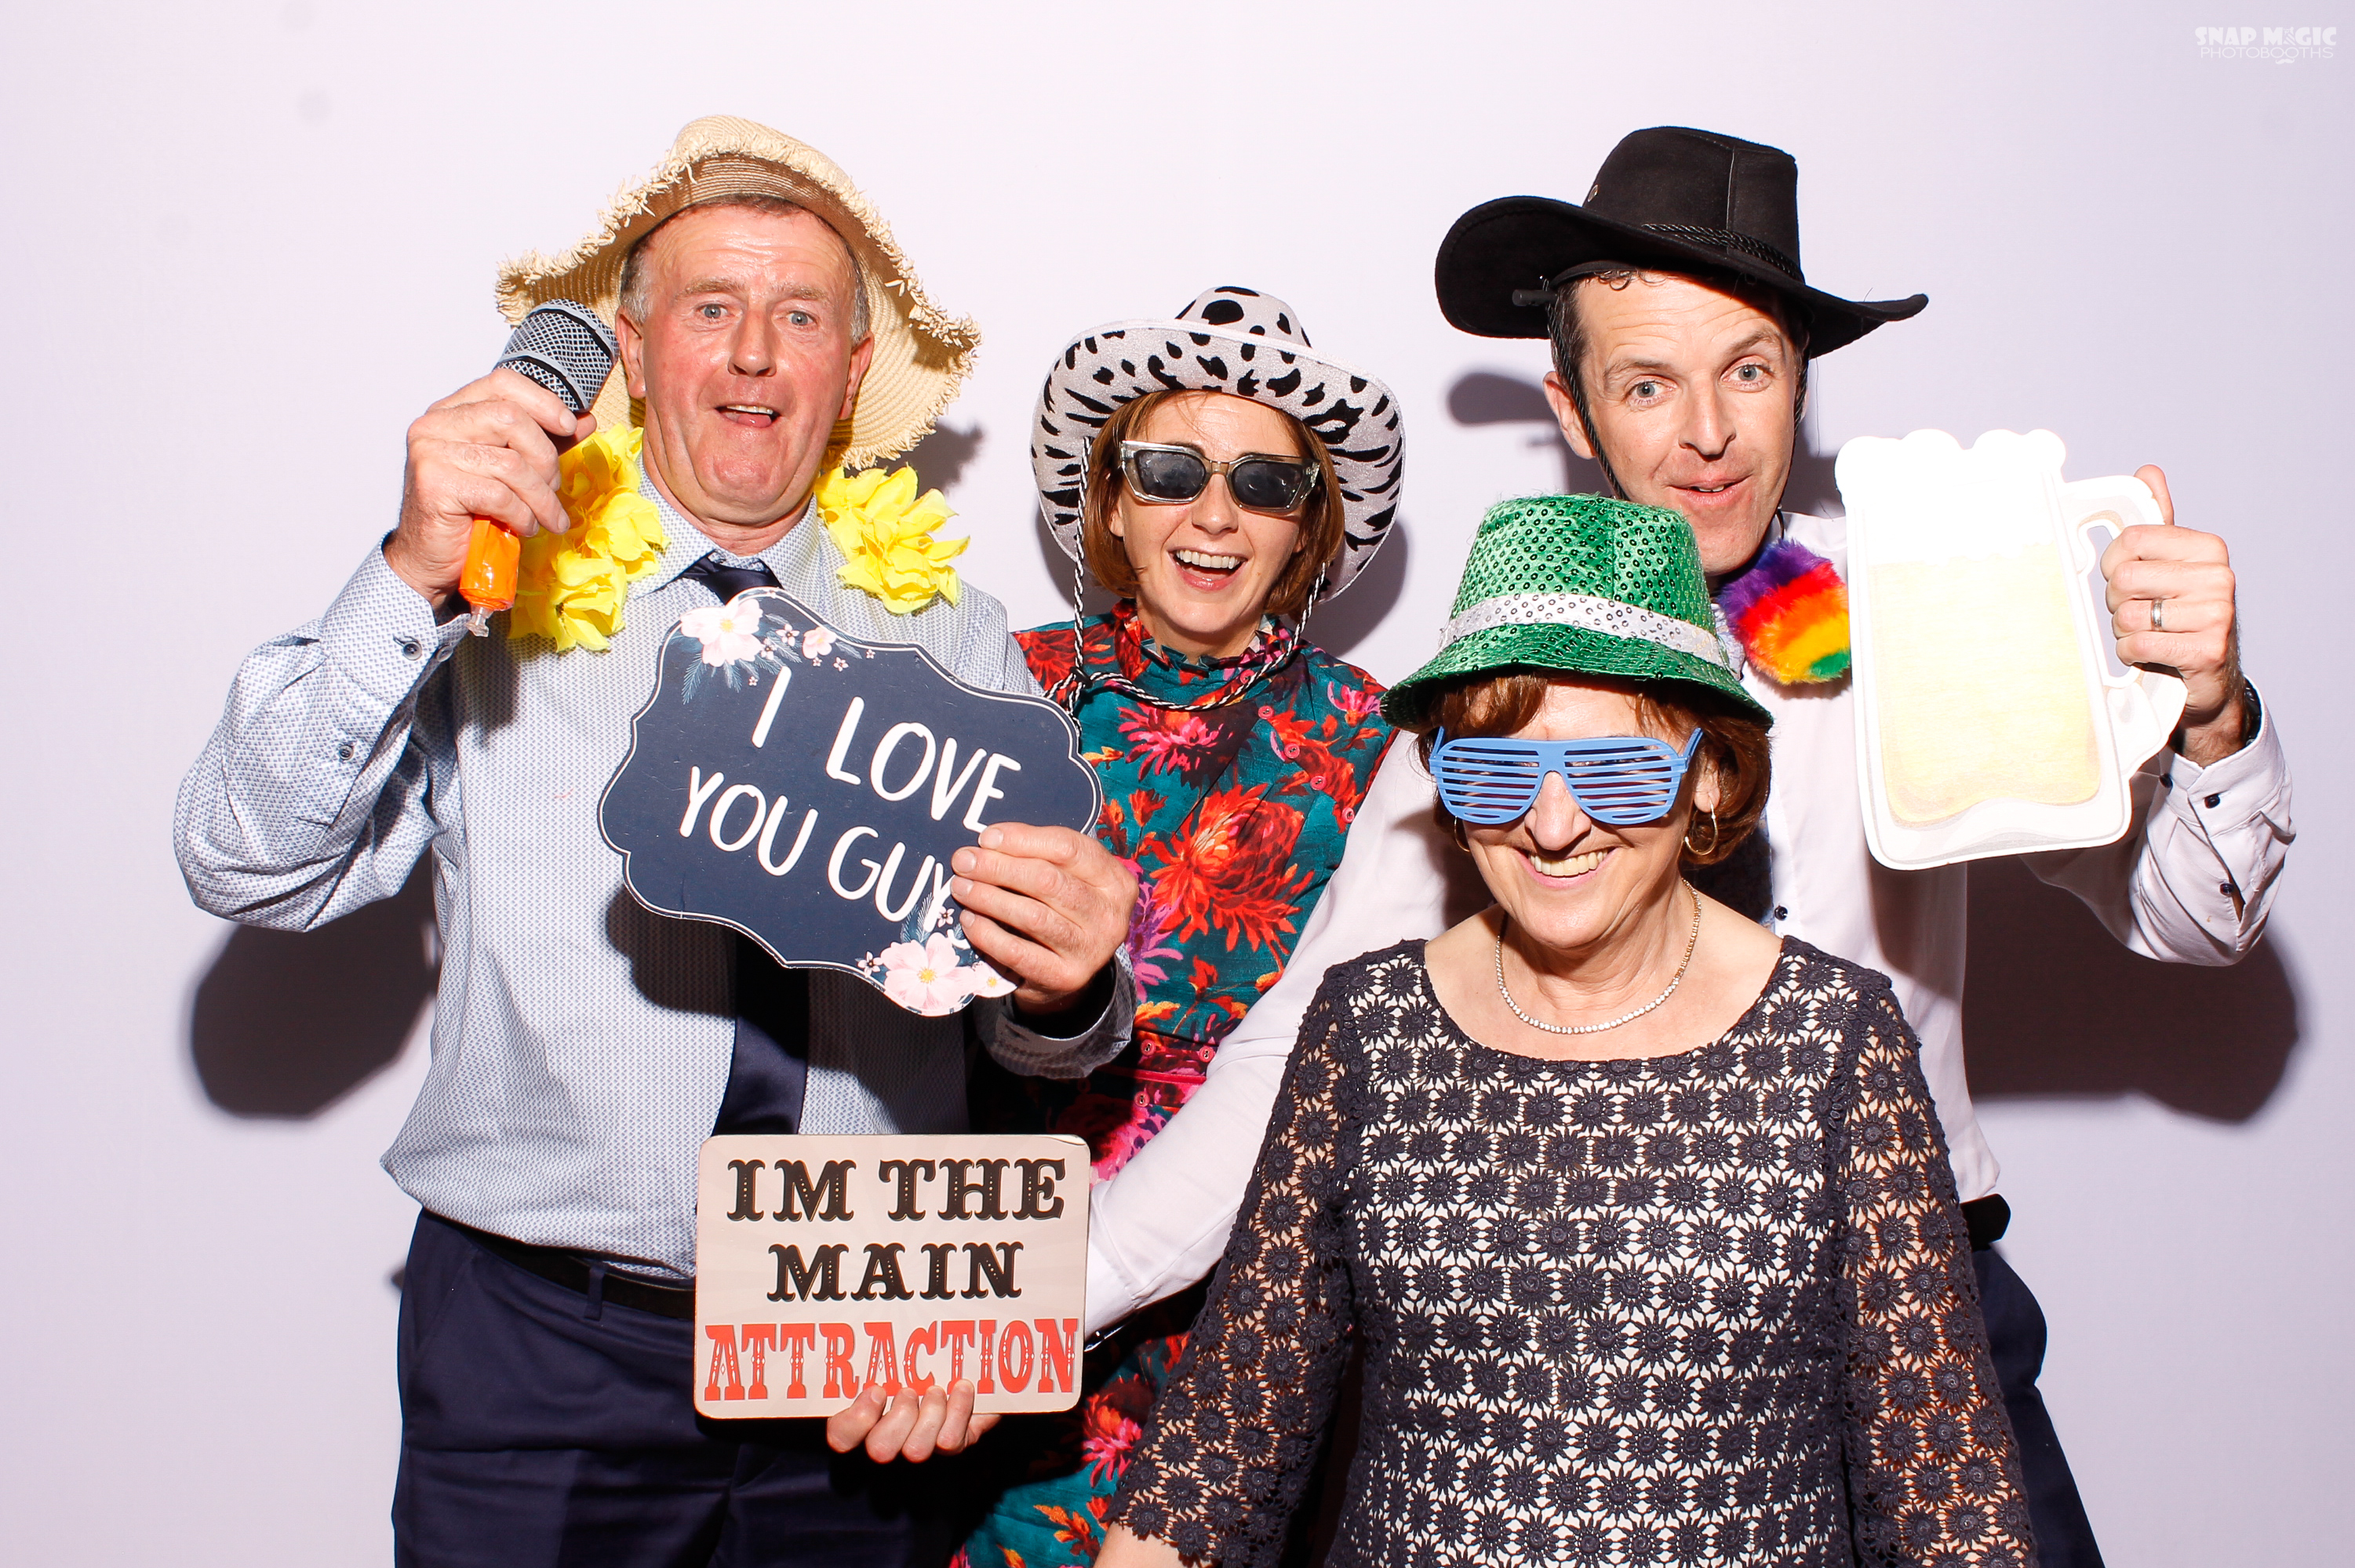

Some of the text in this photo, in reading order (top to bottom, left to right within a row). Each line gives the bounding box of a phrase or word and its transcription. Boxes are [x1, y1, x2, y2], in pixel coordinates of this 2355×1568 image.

[752, 666, 1021, 833] I LOVE
[679, 766, 971, 949] YOU GUY
[726, 1158, 1066, 1222] IM THE
[766, 1241, 1025, 1301] MAIN
[704, 1318, 1079, 1402] ATTRACTION
